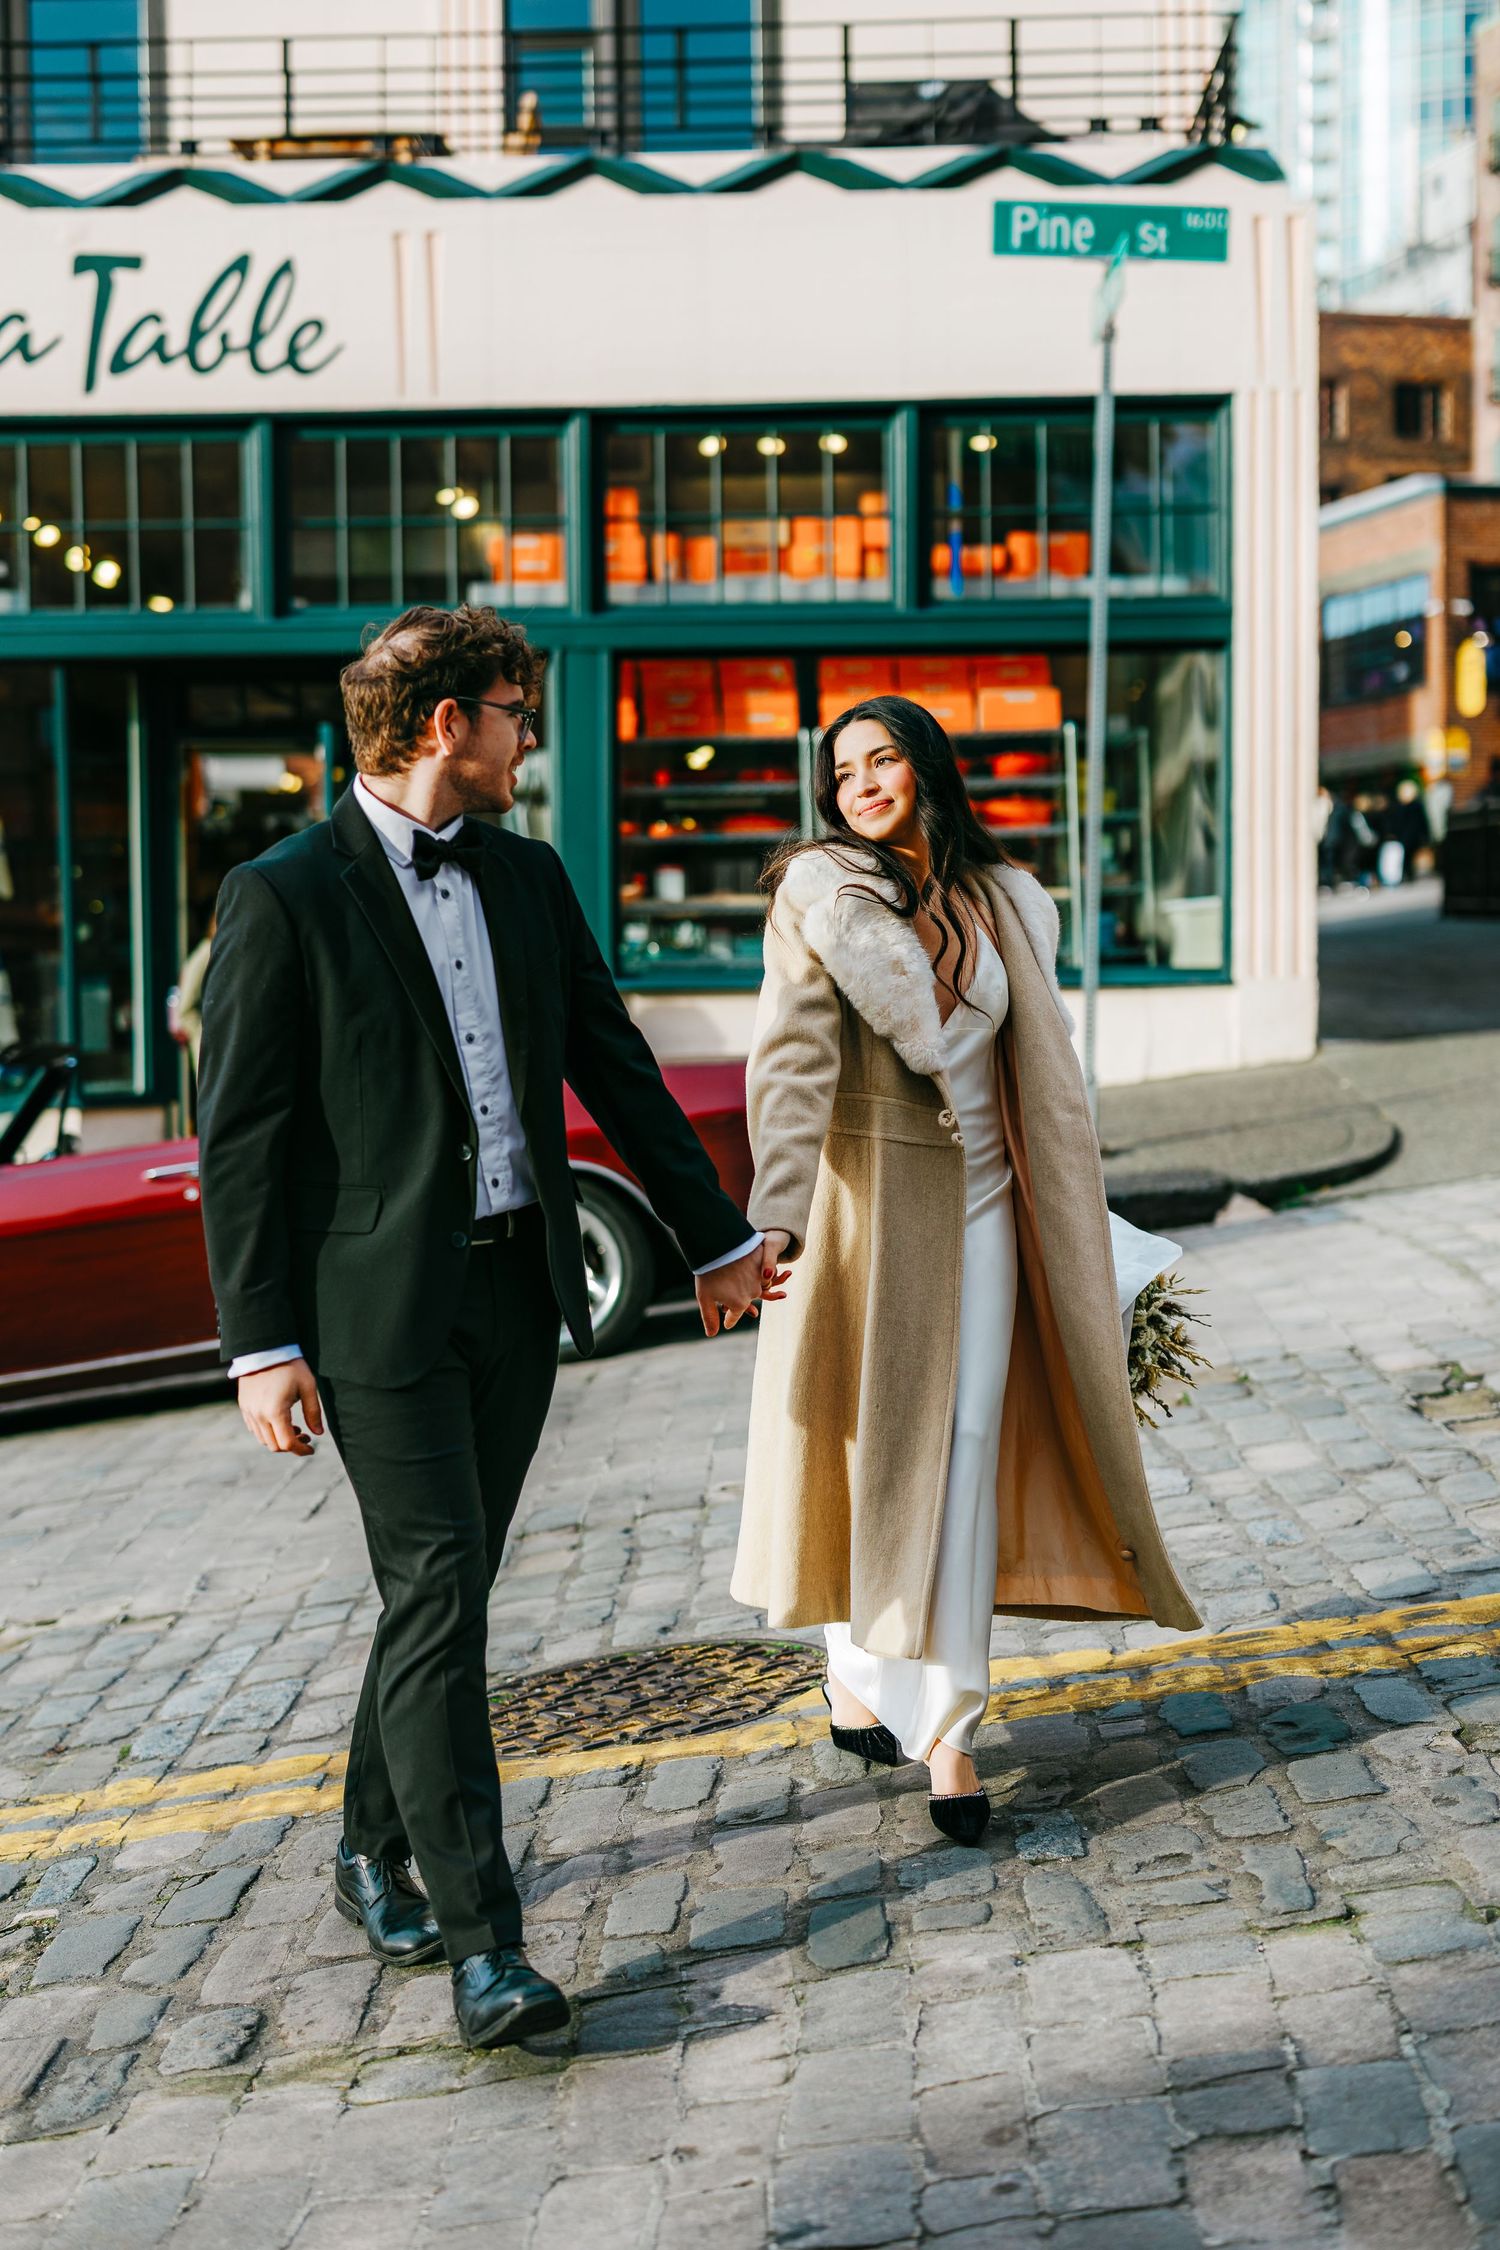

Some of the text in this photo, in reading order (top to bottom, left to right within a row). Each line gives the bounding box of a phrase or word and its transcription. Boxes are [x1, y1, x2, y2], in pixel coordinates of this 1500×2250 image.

[1011, 205, 1167, 253] Pine St
[73, 253, 345, 394] Table
